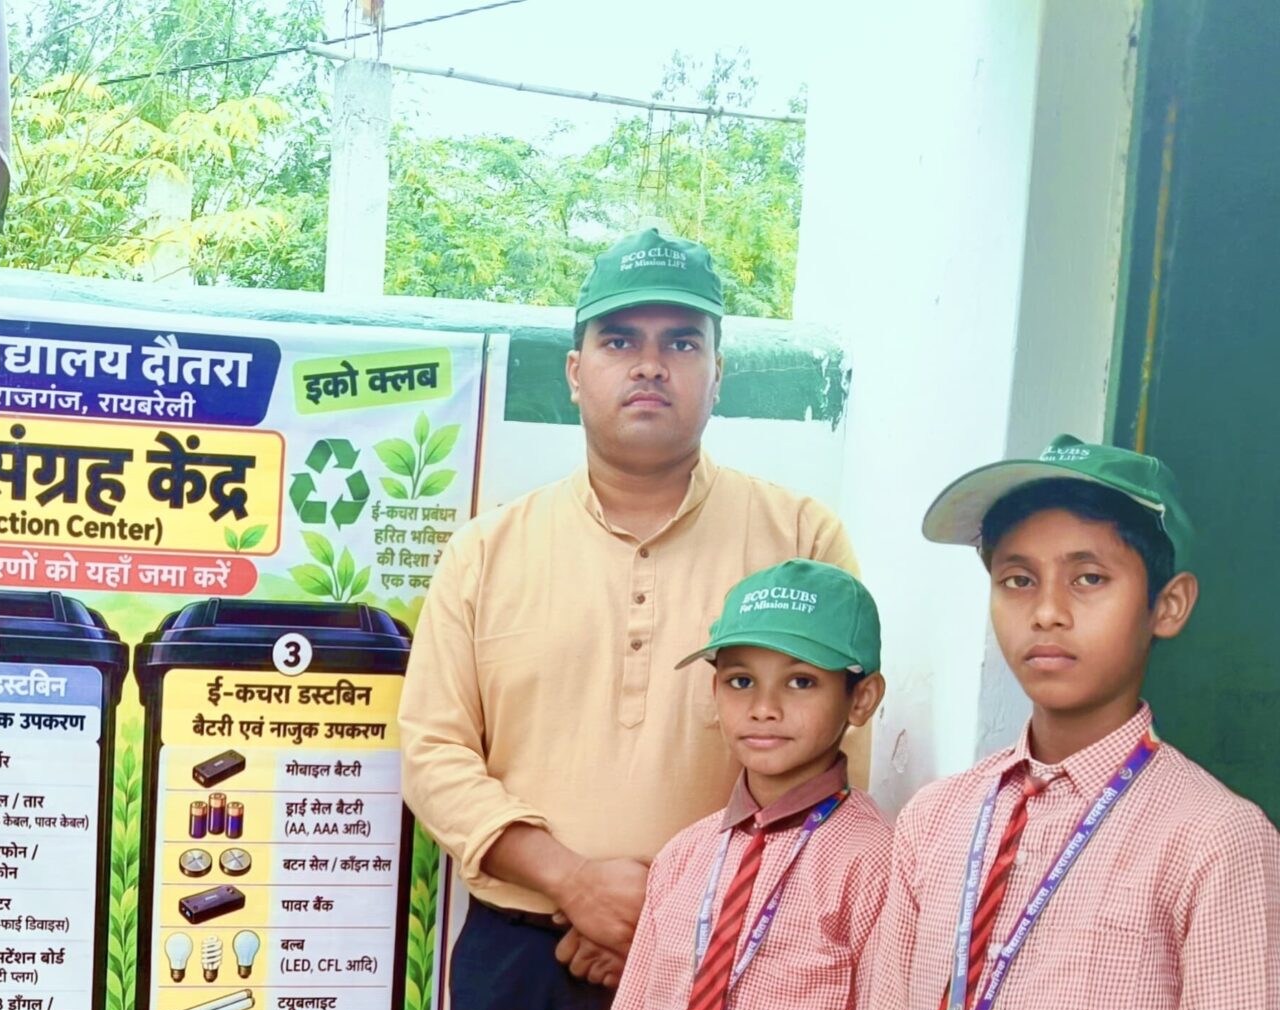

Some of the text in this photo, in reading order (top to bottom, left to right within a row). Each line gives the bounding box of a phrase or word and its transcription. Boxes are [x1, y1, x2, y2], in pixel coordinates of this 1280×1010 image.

[635, 259, 665, 268] Mission
[648, 248, 687, 261] CLUBS
[141, 333, 252, 388] दौतरा
[303, 360, 440, 404] इको क्लब
[98, 389, 196, 419] रायबरेली
[146, 430, 256, 523] केंद्र
[372, 500, 456, 522] ई-कचरा प्रबंधन
[77, 515, 163, 546] Center)
[374, 524, 407, 544] हरित
[46, 552, 78, 583] को
[86, 552, 133, 587] यहाँ
[139, 562, 186, 588] जमा
[193, 560, 231, 590] करें
[381, 574, 404, 590] एक
[754, 599, 789, 610] Mission
[771, 587, 817, 604] CLUBS
[283, 641, 301, 667] 3
[206, 677, 373, 706] ई-कचरा डस्टबिन
[19, 713, 86, 731] उपकरण
[192, 714, 386, 744] बैटरी एवं नाजुक उपकरण
[23, 795, 45, 809] तार
[284, 820, 371, 838] (AA, AAA आदि)
[25, 916, 69, 933] डिवाइस)
[280, 938, 305, 951] बल्ब
[40, 949, 65, 965] बोर्ड
[280, 956, 378, 974] (LED, CFL आदि)
